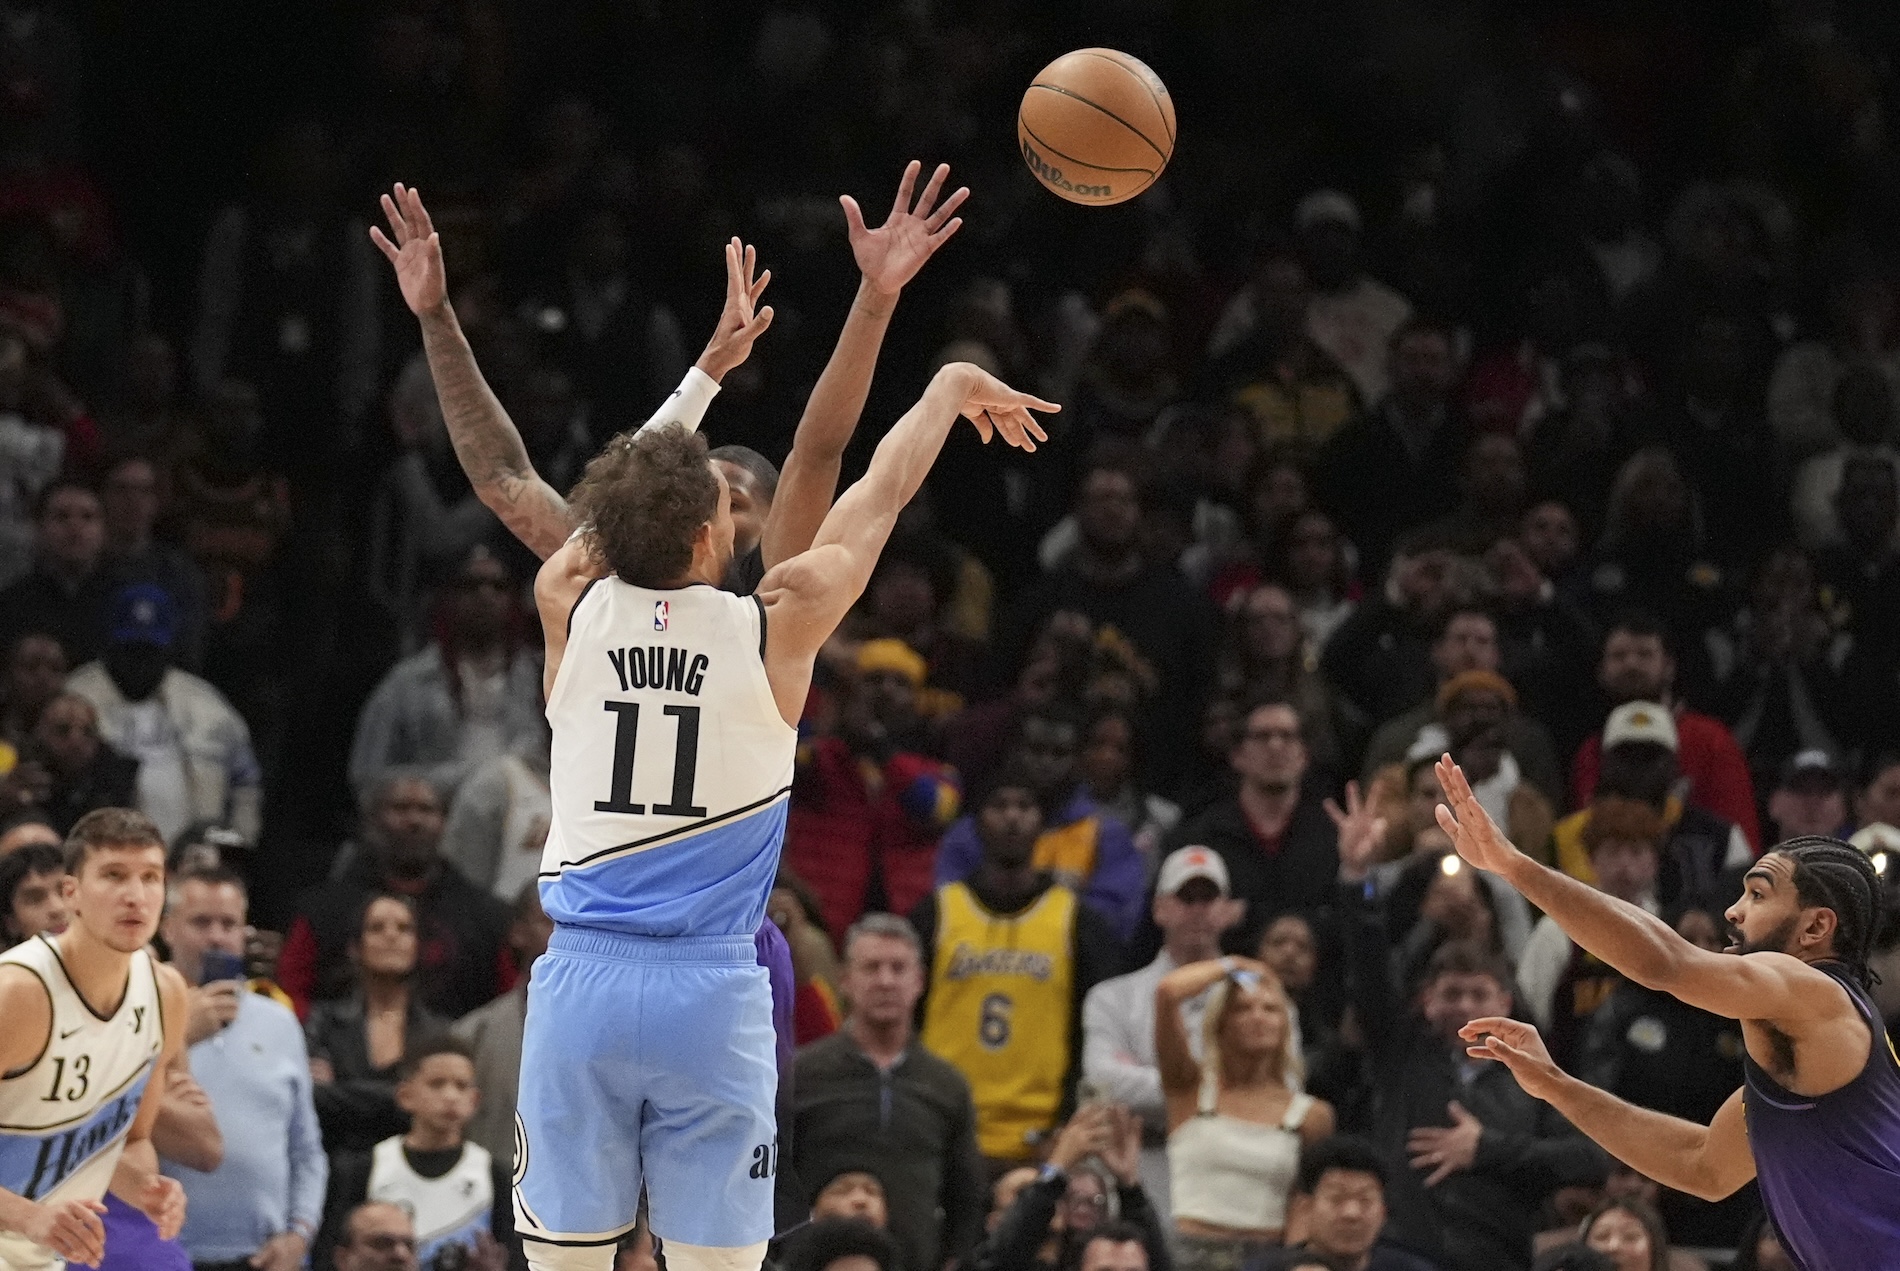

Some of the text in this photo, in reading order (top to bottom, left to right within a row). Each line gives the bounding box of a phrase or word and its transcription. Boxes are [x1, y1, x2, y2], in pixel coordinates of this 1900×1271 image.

[1023, 137, 1111, 196] Wilson
[608, 646, 709, 696] YOUNG
[594, 700, 707, 818] 11
[978, 992, 1012, 1050] 6
[41, 1055, 91, 1101] 13
